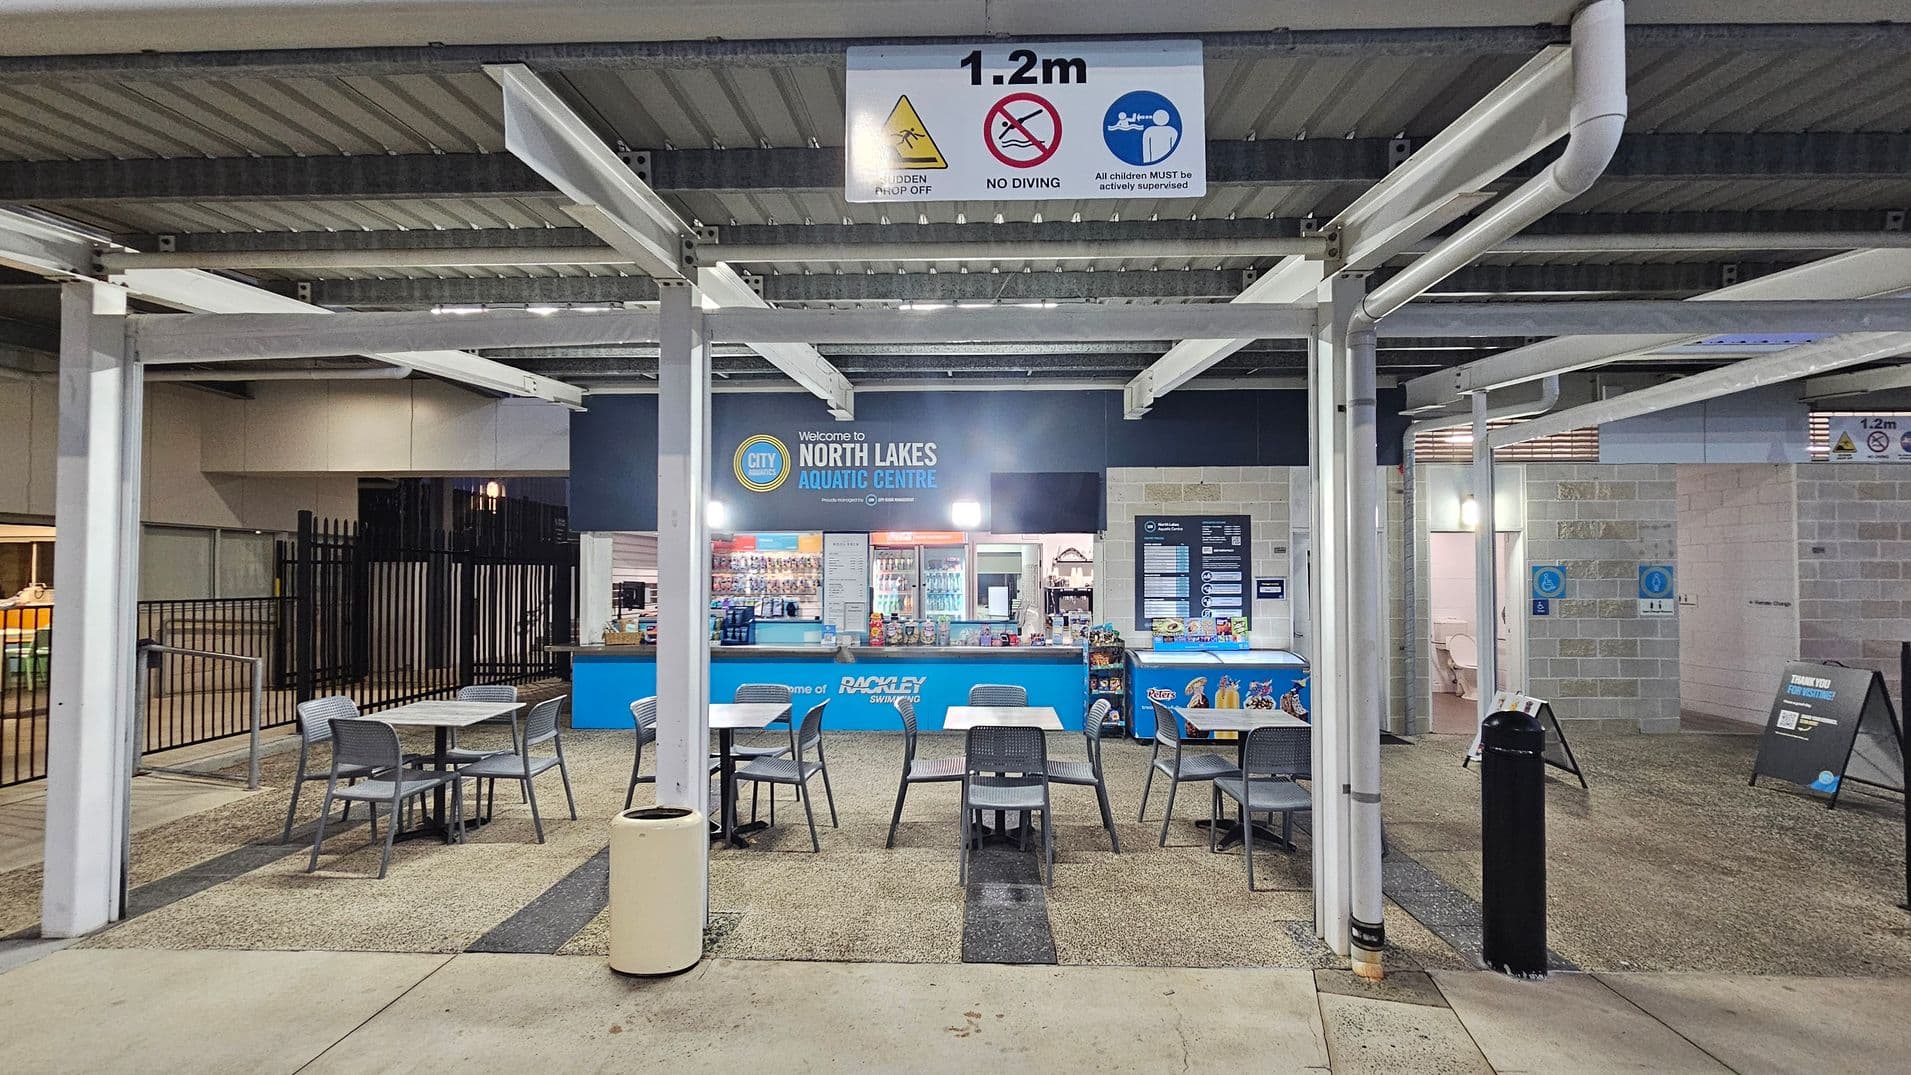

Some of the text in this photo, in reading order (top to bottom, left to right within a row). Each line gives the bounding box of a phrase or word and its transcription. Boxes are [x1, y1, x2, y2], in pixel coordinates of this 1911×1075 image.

[960, 50, 1087, 86] 1.2m
[1095, 171, 1192, 180] All children MUST be
[987, 177, 1061, 189] NO DIVING
[1100, 181, 1189, 191] actively supervised
[875, 185, 932, 195] DROP OFF
[1860, 418, 1897, 430] 1.2m
[798, 431, 866, 441] Welcome to
[748, 452, 776, 468] CITY
[799, 442, 938, 467] NORTH LAKES
[798, 469, 938, 489] AQUATIC CENTRE
[838, 676, 927, 694] RACKLEY
[1791, 674, 1831, 689] THANK YOU
[814, 684, 828, 694] of
[1148, 688, 1176, 699] Peters
[1787, 684, 1802, 695] FOR
